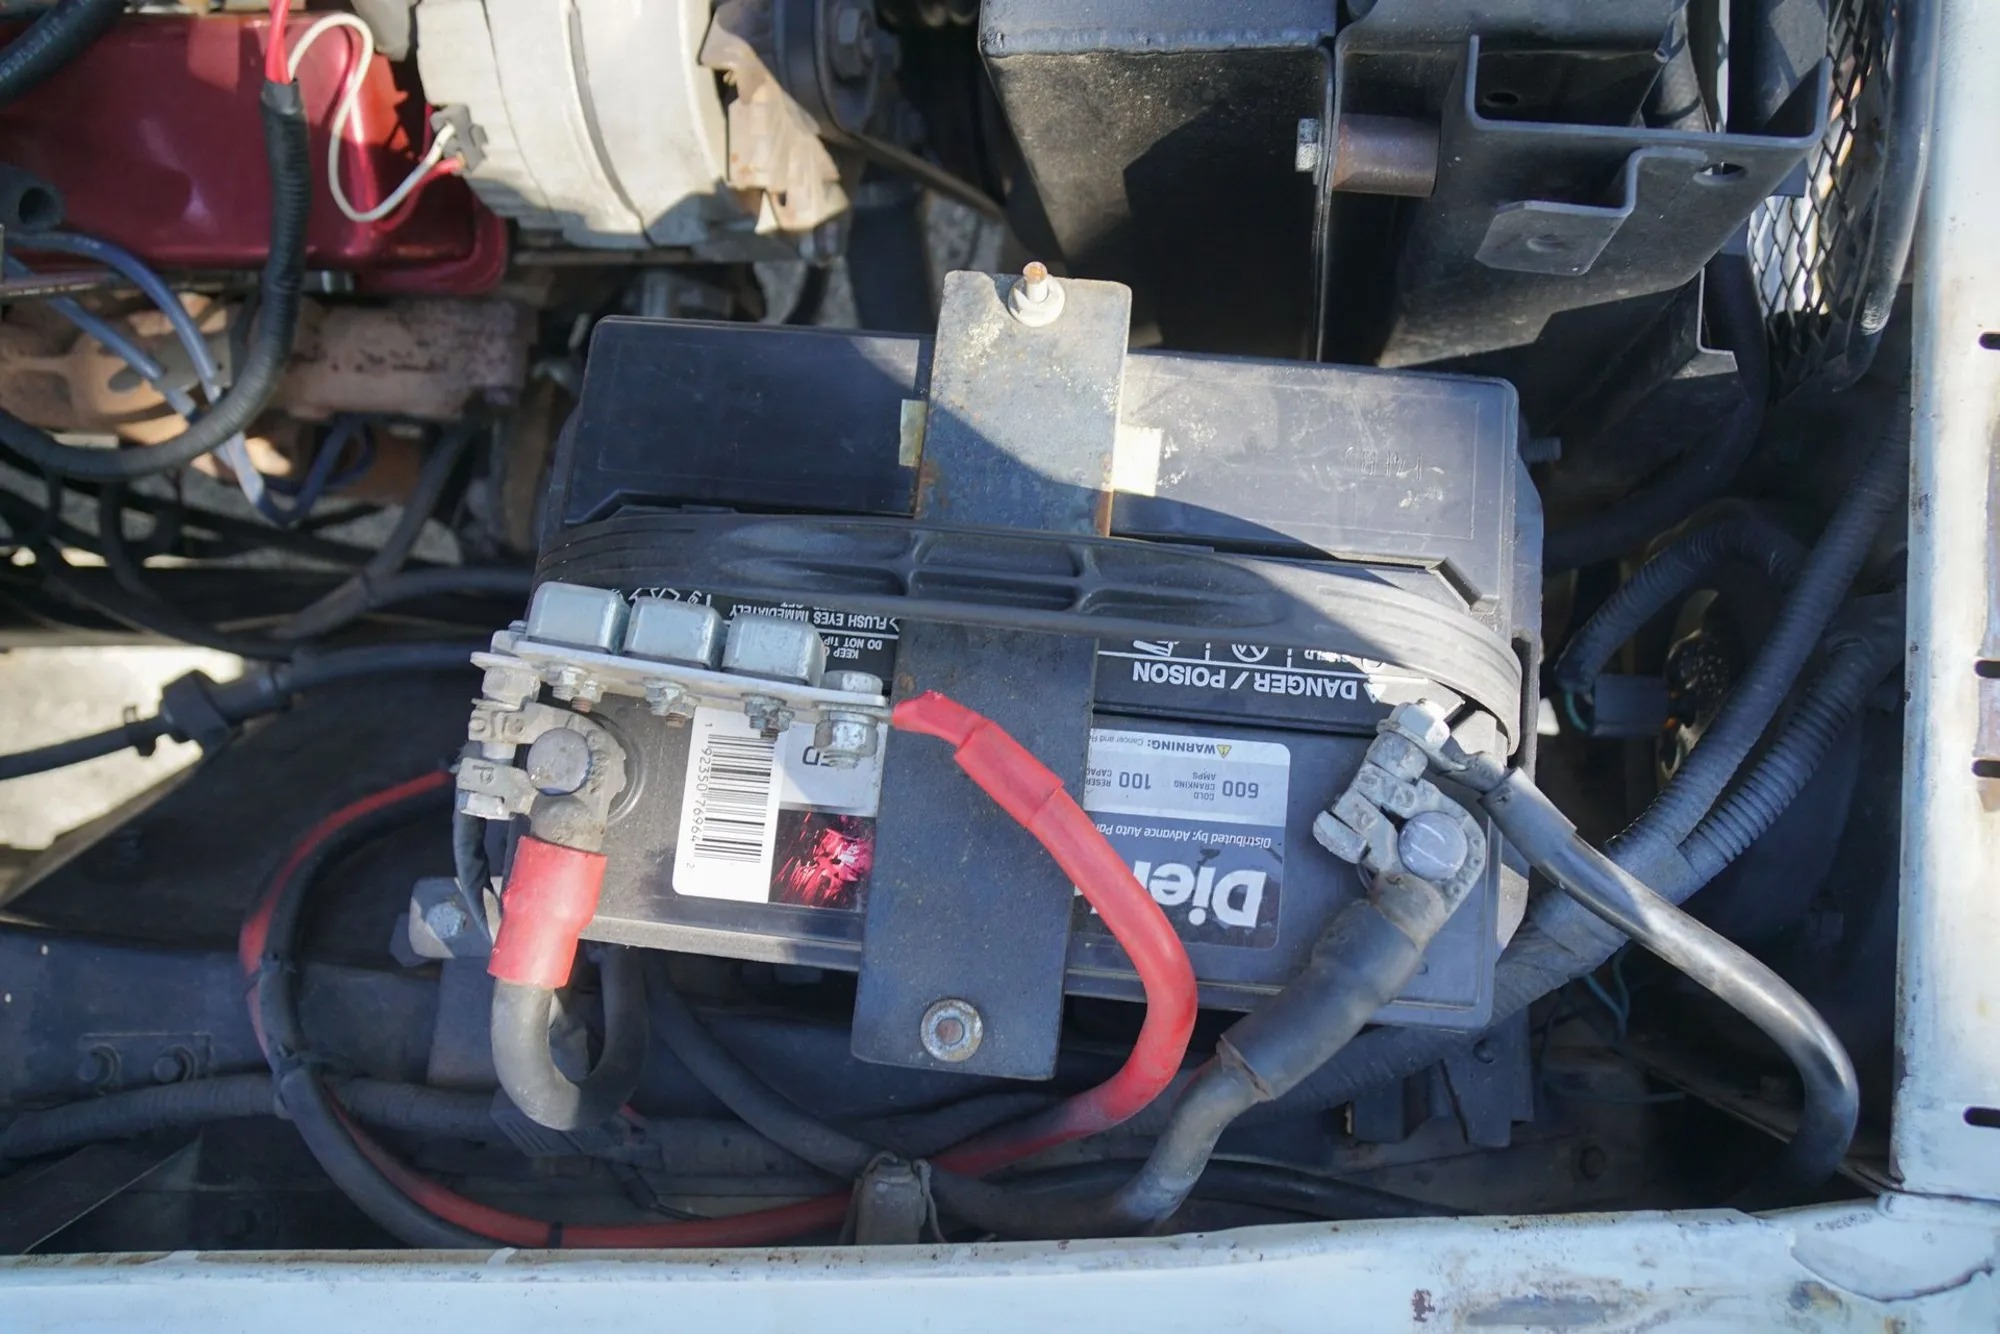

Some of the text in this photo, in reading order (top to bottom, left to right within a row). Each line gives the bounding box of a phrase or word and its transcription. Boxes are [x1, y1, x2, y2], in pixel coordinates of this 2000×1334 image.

[812, 610, 843, 625] EYES
[847, 614, 886, 629] FLUSH
[842, 637, 864, 647] NOT
[866, 639, 882, 649] DO
[832, 647, 858, 659] KEEP
[1132, 660, 1225, 687] POISON
[1254, 672, 1357, 699] DANGER
[1099, 734, 1114, 743] and
[1115, 735, 1143, 745] Cancer
[1147, 739, 1214, 754] WARNING:
[1118, 771, 1150, 789] 100
[1191, 771, 1215, 780] AMPS
[1173, 779, 1215, 790] CRANKING
[1221, 780, 1258, 798] 600
[688, 746, 712, 842] 92350 76964
[1193, 791, 1214, 800] COLD
[1115, 824, 1141, 837] Auto
[1143, 827, 1190, 841] Advance
[1191, 829, 1208, 843] by:
[1210, 832, 1270, 848] Distributed
